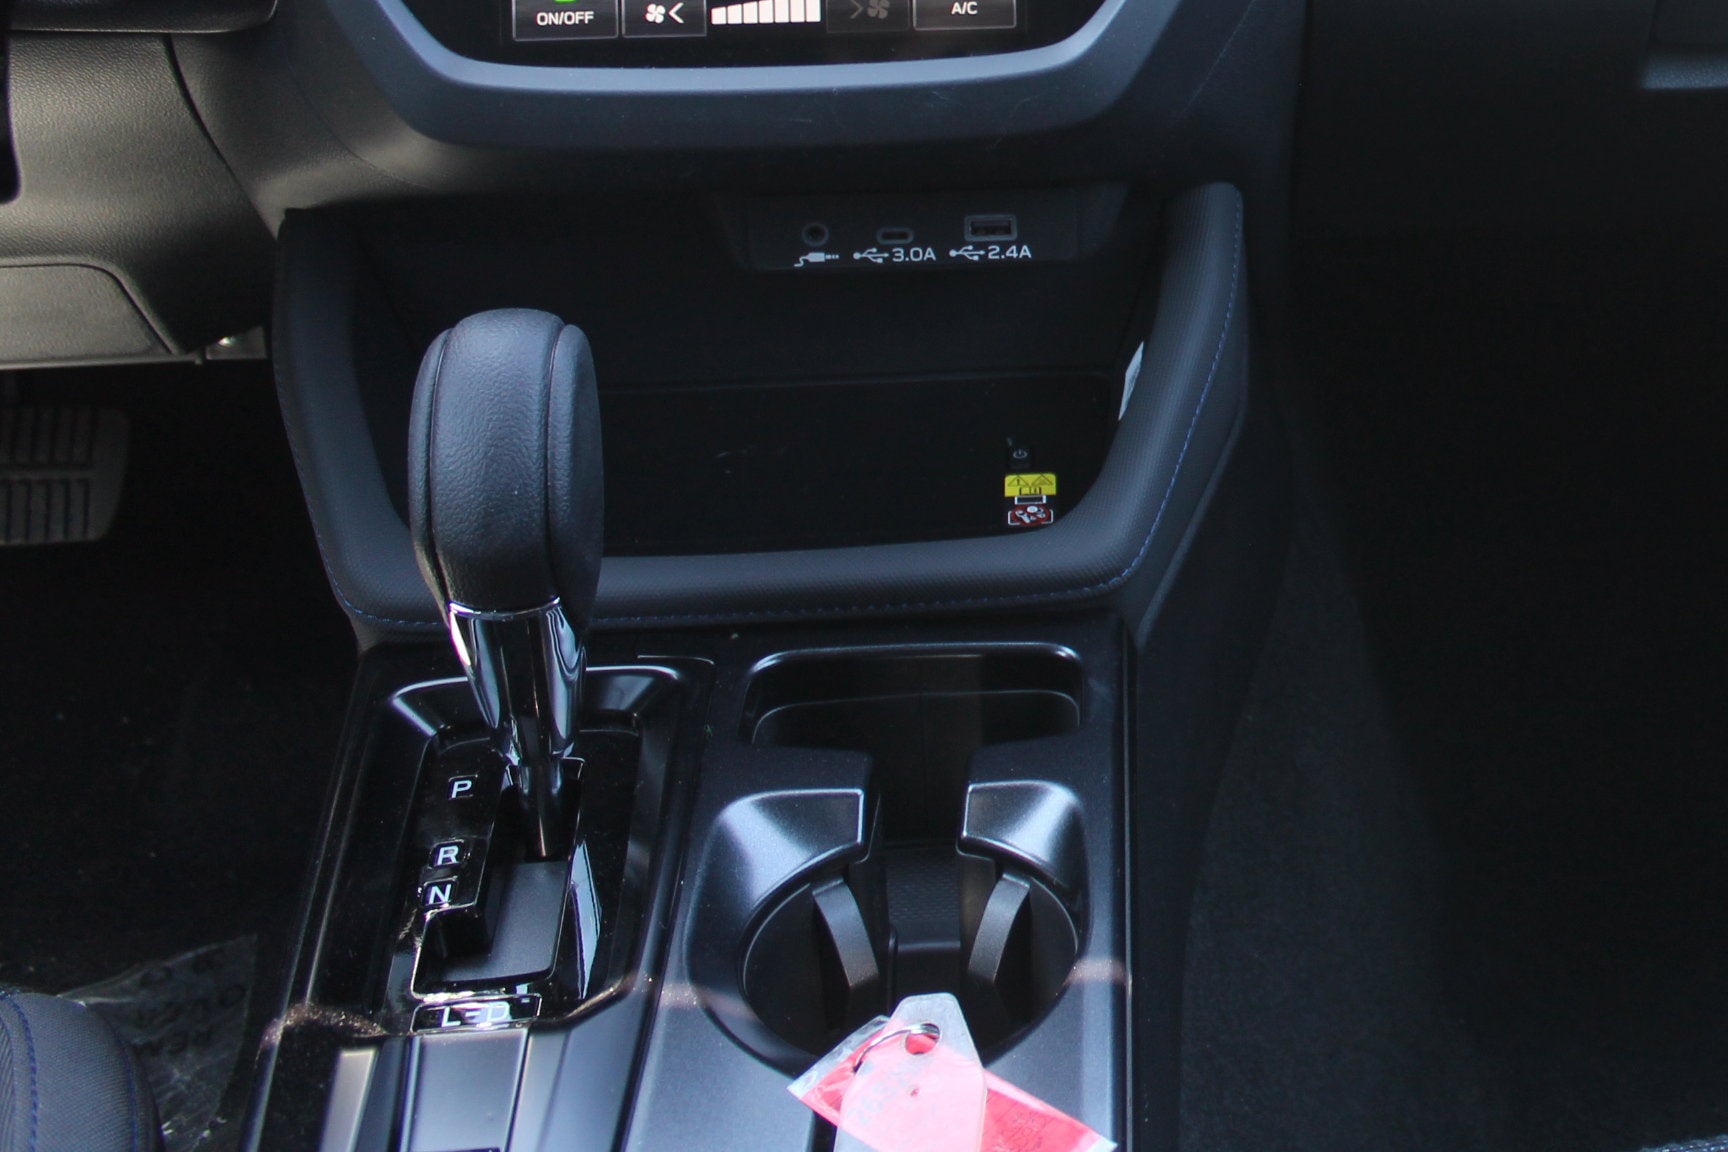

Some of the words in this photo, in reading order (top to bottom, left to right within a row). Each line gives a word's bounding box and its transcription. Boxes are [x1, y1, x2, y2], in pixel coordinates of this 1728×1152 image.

[951, 1, 978, 15] A/C
[536, 11, 595, 26] ON/OFF
[892, 248, 937, 262] 3.0A
[987, 245, 1032, 260] 2.4A
[451, 780, 472, 798] P
[437, 845, 459, 866] R
[428, 884, 451, 905] N
